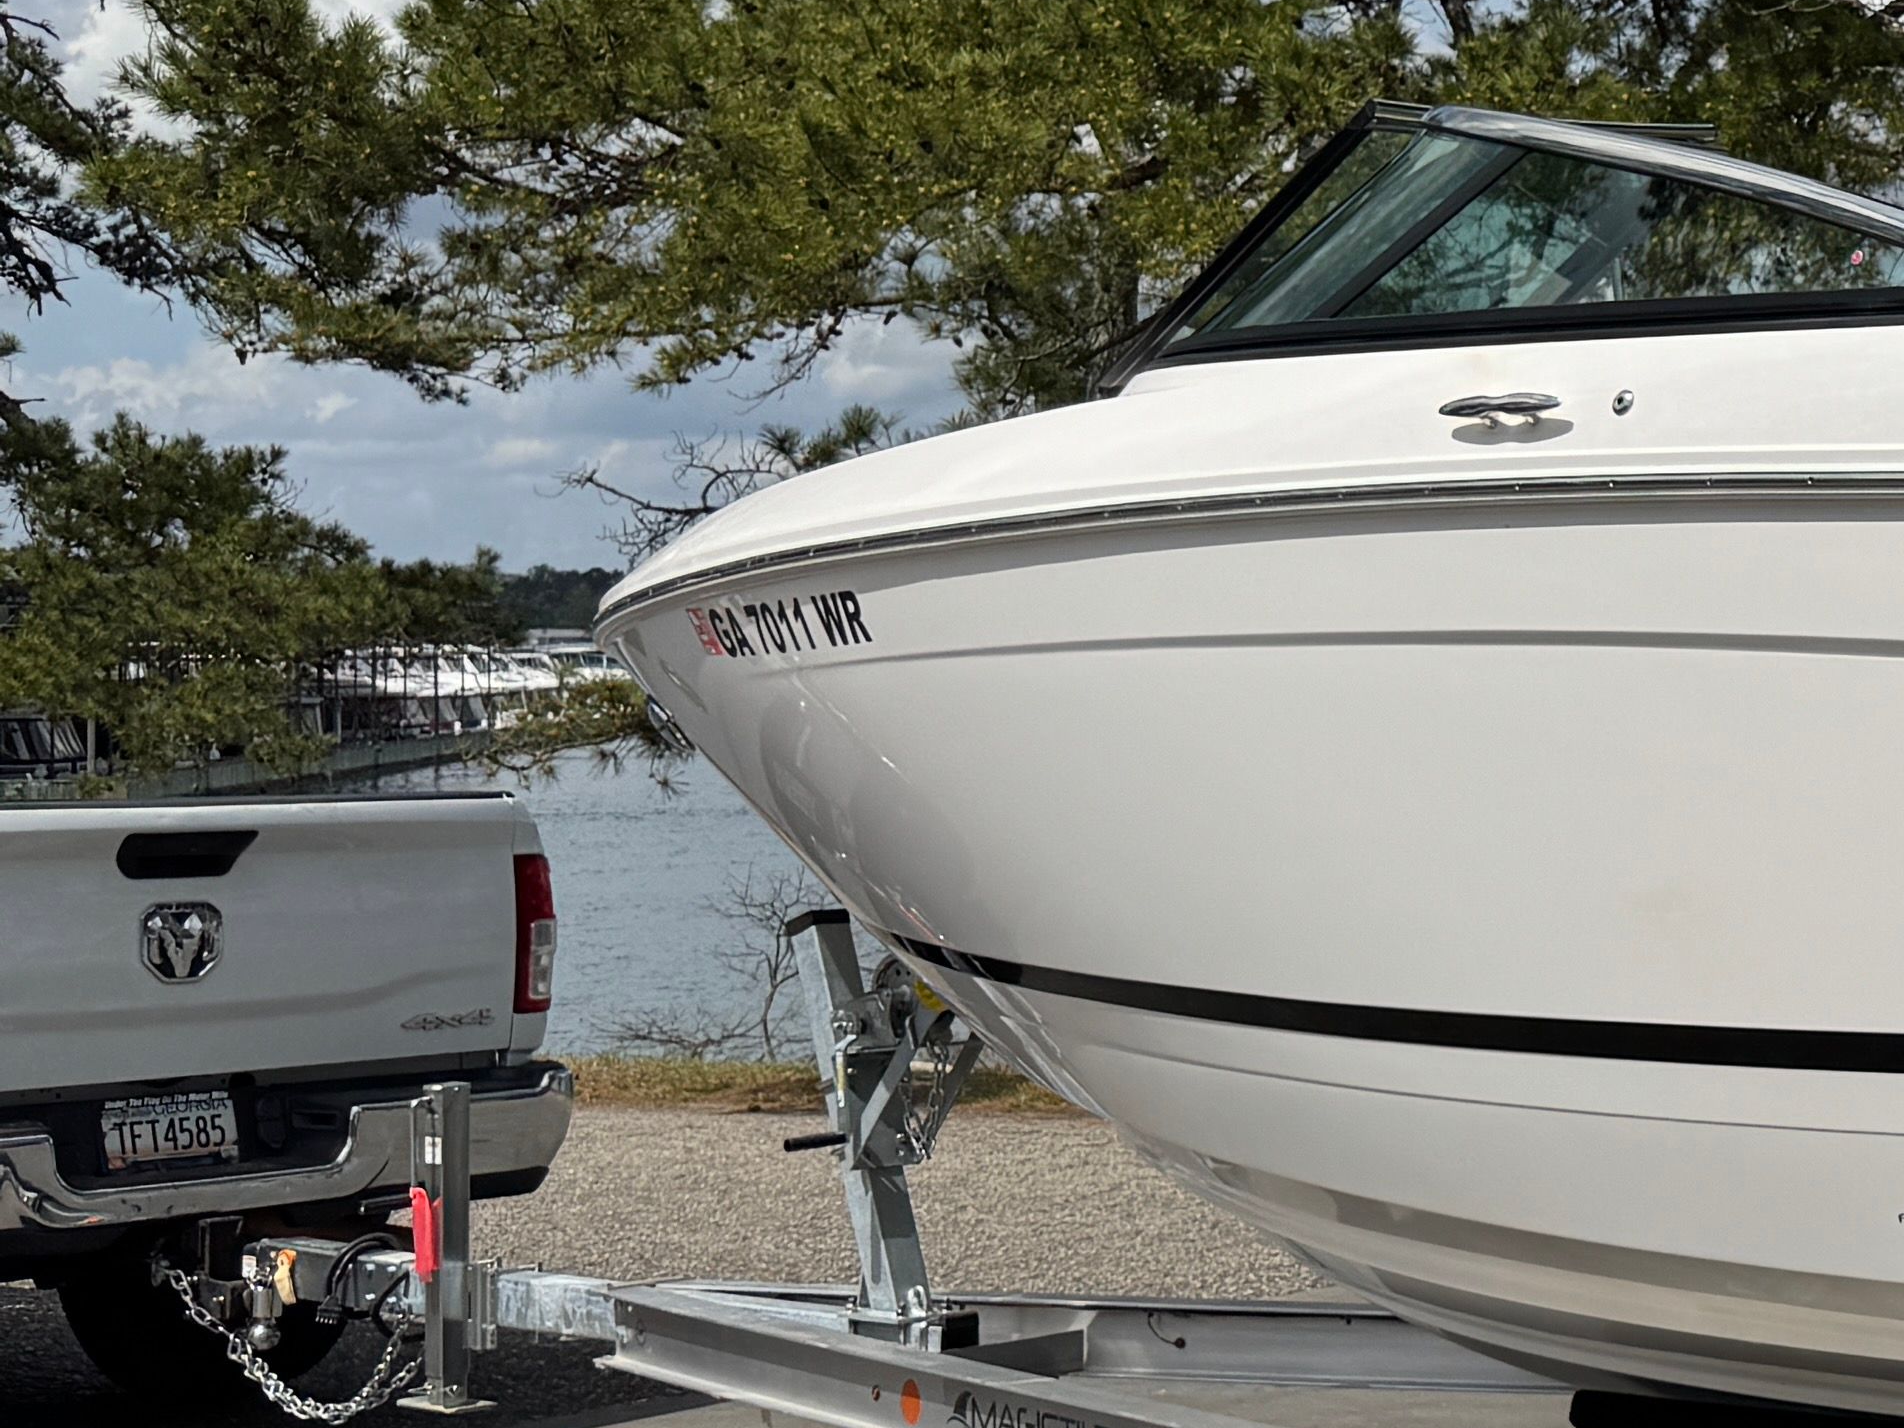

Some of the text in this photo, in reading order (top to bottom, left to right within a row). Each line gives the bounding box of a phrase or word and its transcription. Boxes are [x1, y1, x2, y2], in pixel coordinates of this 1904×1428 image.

[708, 608, 756, 658] GA
[743, 597, 817, 655] 7011
[810, 590, 873, 647] WR
[152, 1099, 228, 1116] GEORGIA
[114, 1114, 226, 1155] TFT4585
